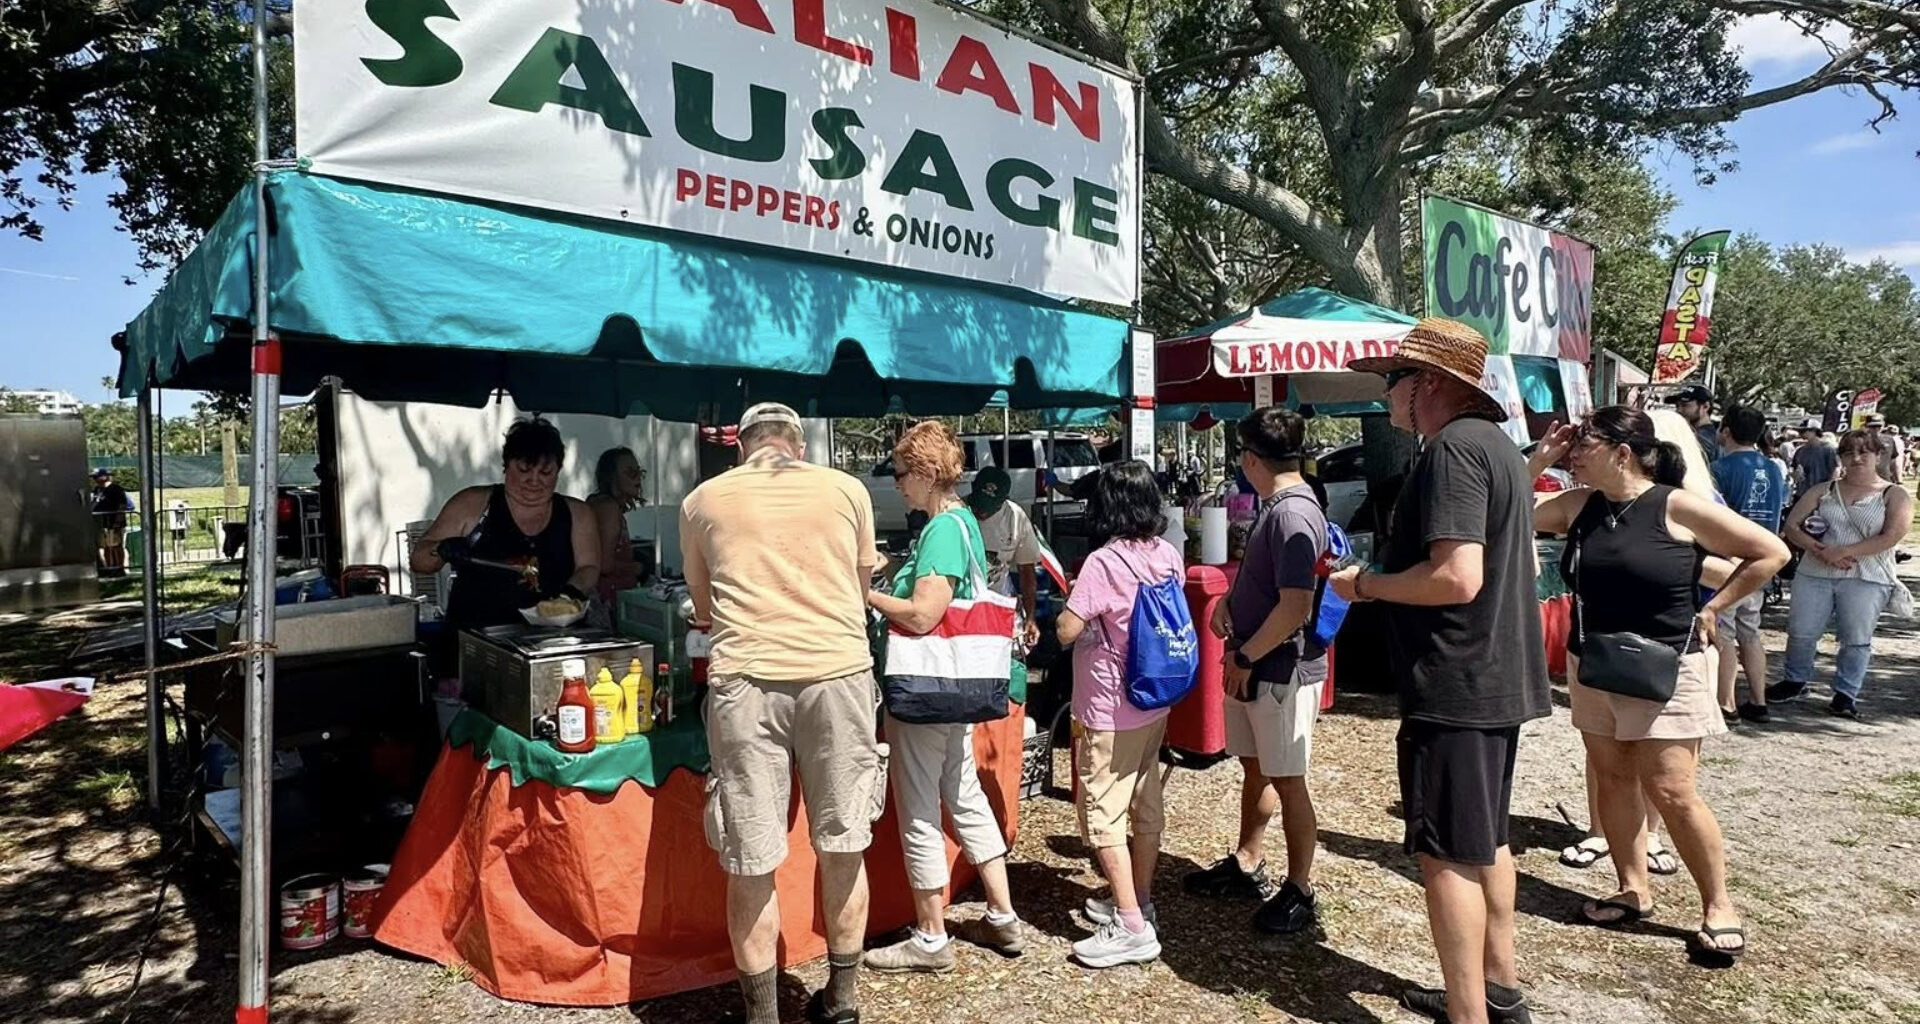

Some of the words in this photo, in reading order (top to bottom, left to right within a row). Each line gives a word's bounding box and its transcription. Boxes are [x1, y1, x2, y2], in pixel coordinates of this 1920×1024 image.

[359, 0, 1120, 246] SAUSAGE
[675, 167, 841, 231] PEPPERS
[853, 206, 874, 238] &
[886, 206, 995, 261] ONIONS
[1434, 220, 1532, 337] Cafe
[1836, 390, 1851, 433] COLD
